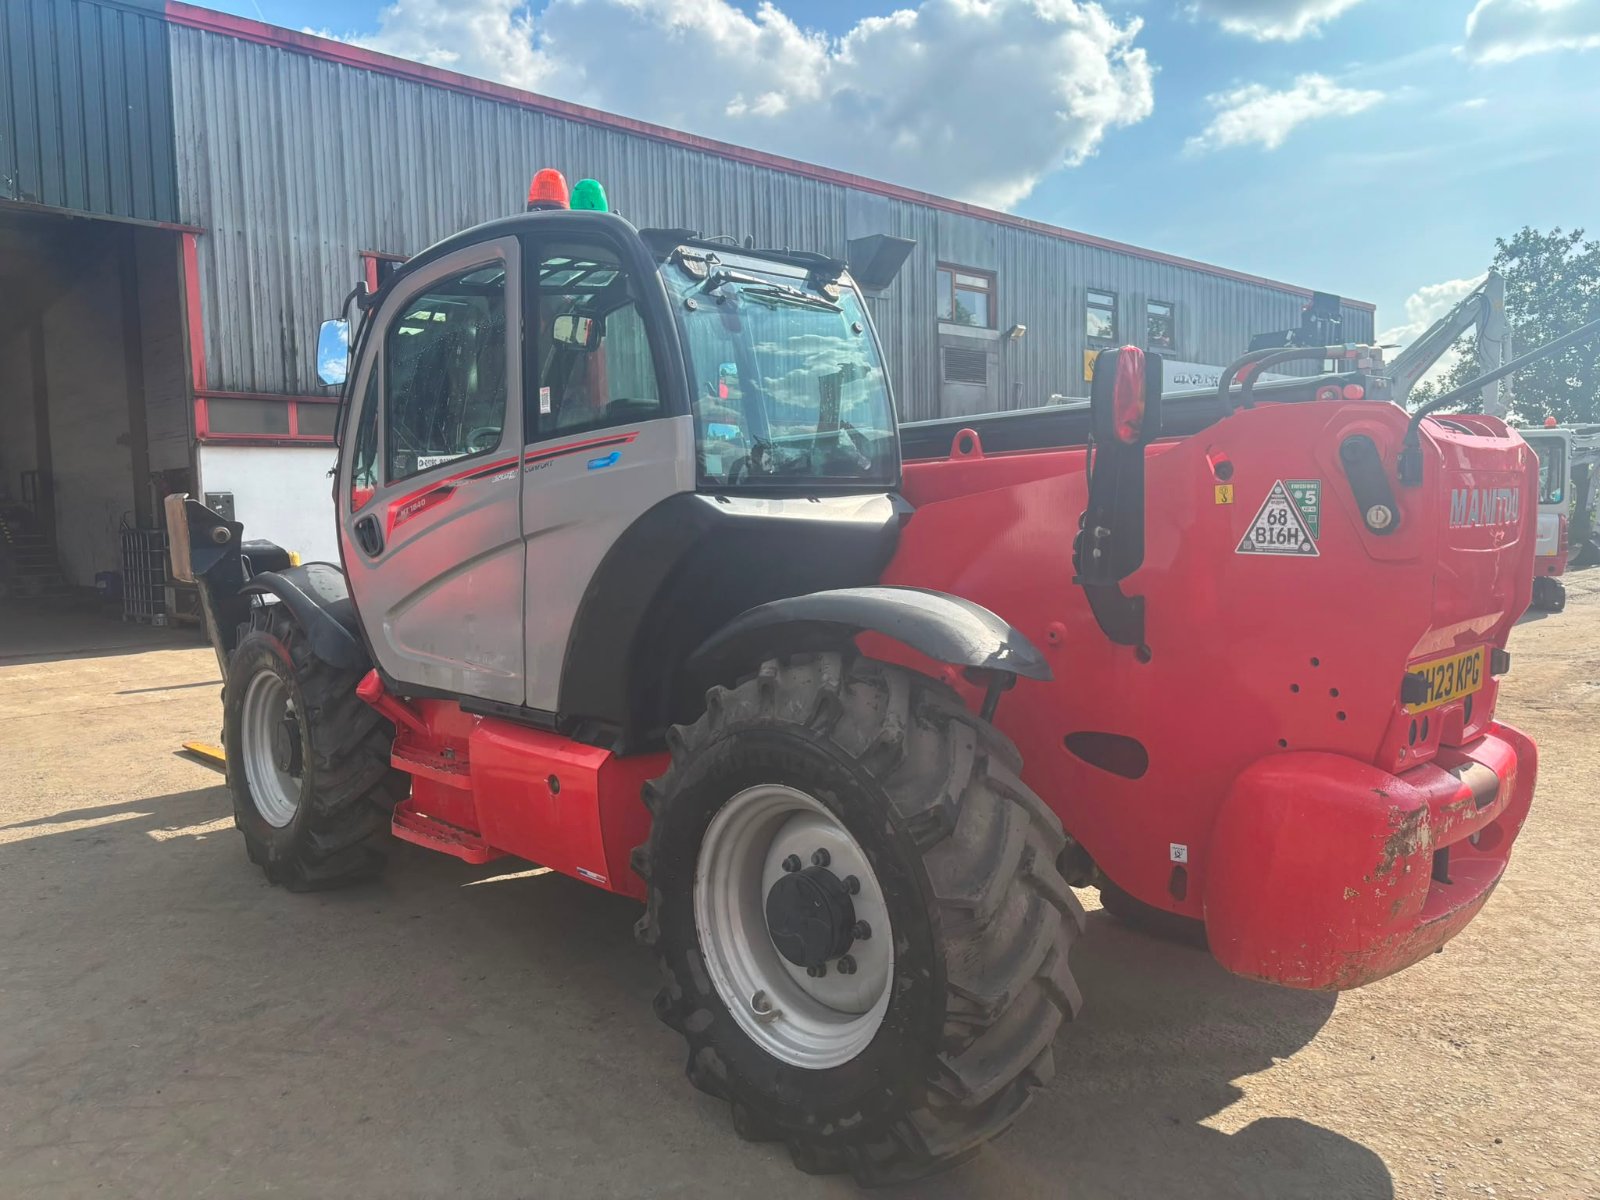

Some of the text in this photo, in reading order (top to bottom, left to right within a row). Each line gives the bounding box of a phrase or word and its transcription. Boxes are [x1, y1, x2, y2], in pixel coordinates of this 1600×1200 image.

[1304, 490, 1317, 505] 5
[1450, 488, 1520, 527] MANITOU
[1267, 508, 1288, 526] 68
[1416, 652, 1480, 705] H23 KPG
